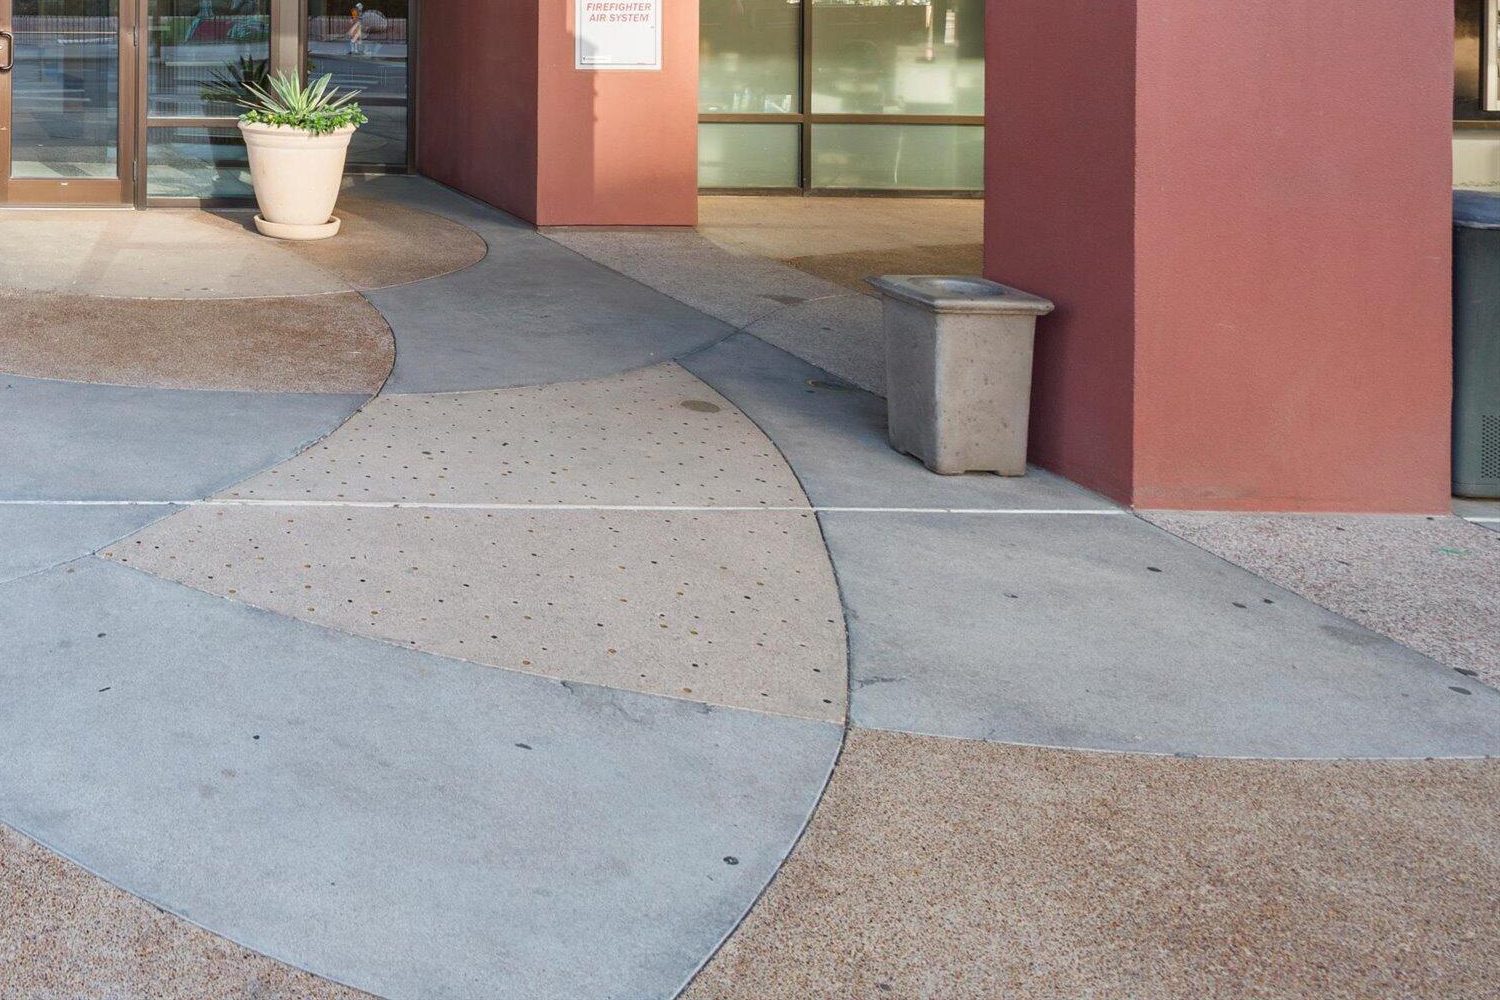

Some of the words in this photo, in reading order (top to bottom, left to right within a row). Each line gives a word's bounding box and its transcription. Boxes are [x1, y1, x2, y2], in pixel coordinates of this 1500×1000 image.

[586, 2, 652, 12] FIREFIGHTER
[589, 13, 606, 23] AIR
[609, 13, 649, 23] SYSTEM
